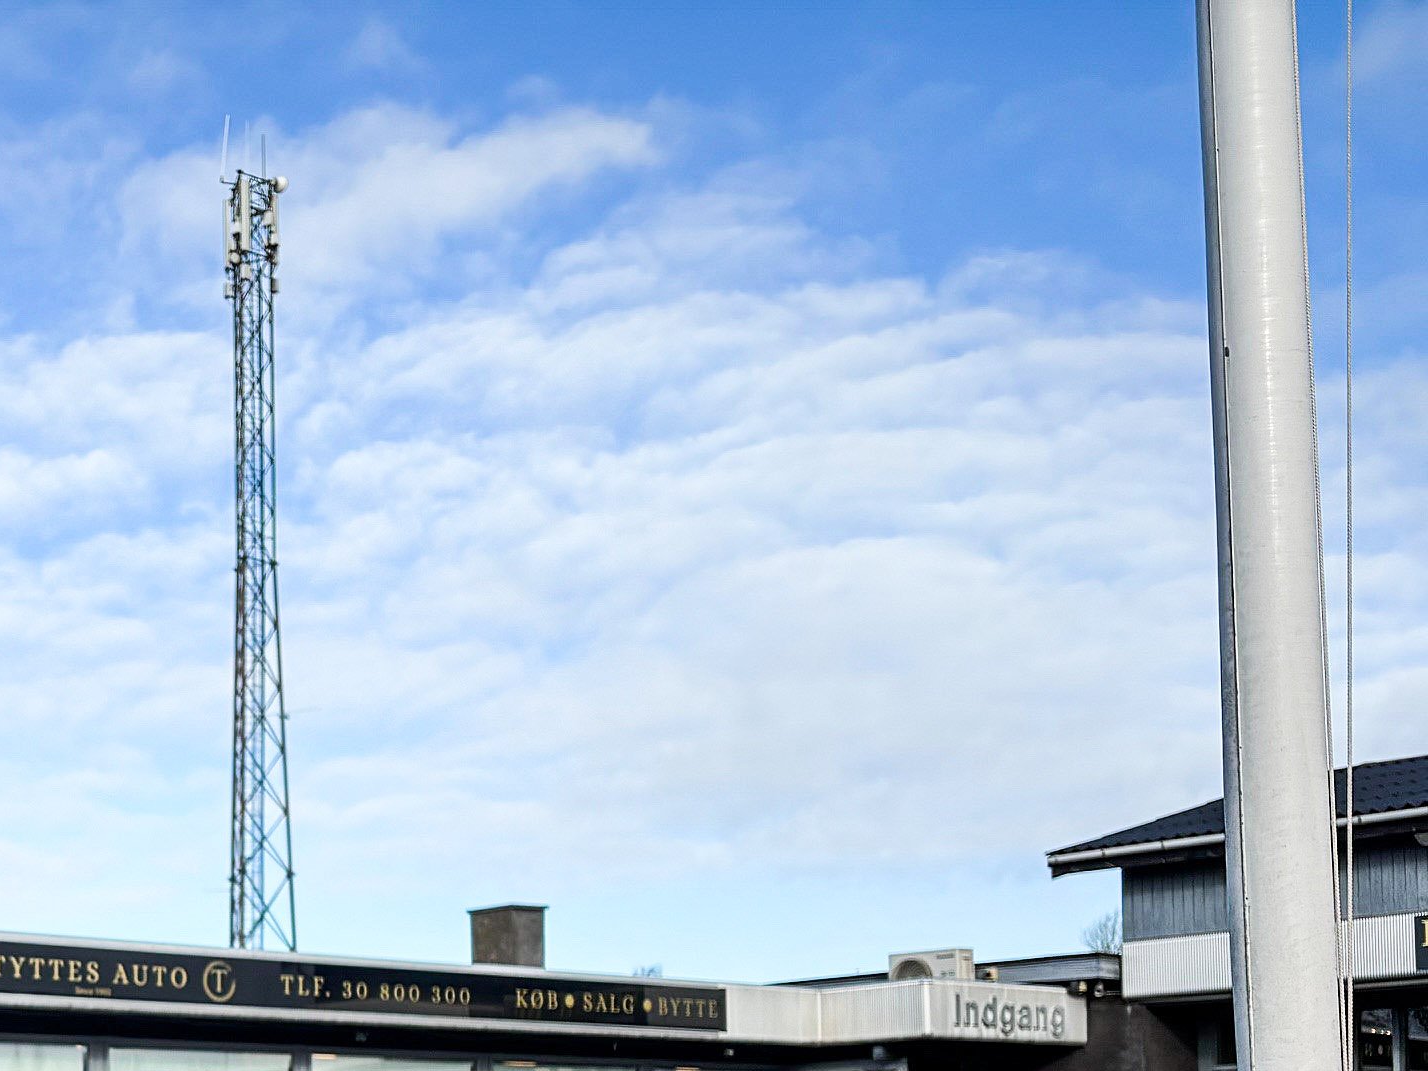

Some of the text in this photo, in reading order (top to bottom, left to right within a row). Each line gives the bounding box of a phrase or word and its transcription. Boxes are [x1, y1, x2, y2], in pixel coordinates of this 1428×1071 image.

[112, 963, 188, 989] AUTO
[280, 973, 331, 999] TLF.
[342, 980, 369, 1001] 30
[379, 983, 421, 1004] 800
[431, 985, 471, 1007] 300
[515, 988, 559, 1011] KØB
[582, 991, 635, 1015] SALG
[657, 996, 720, 1020] BYTTE
[953, 993, 1066, 1040] Indgang
